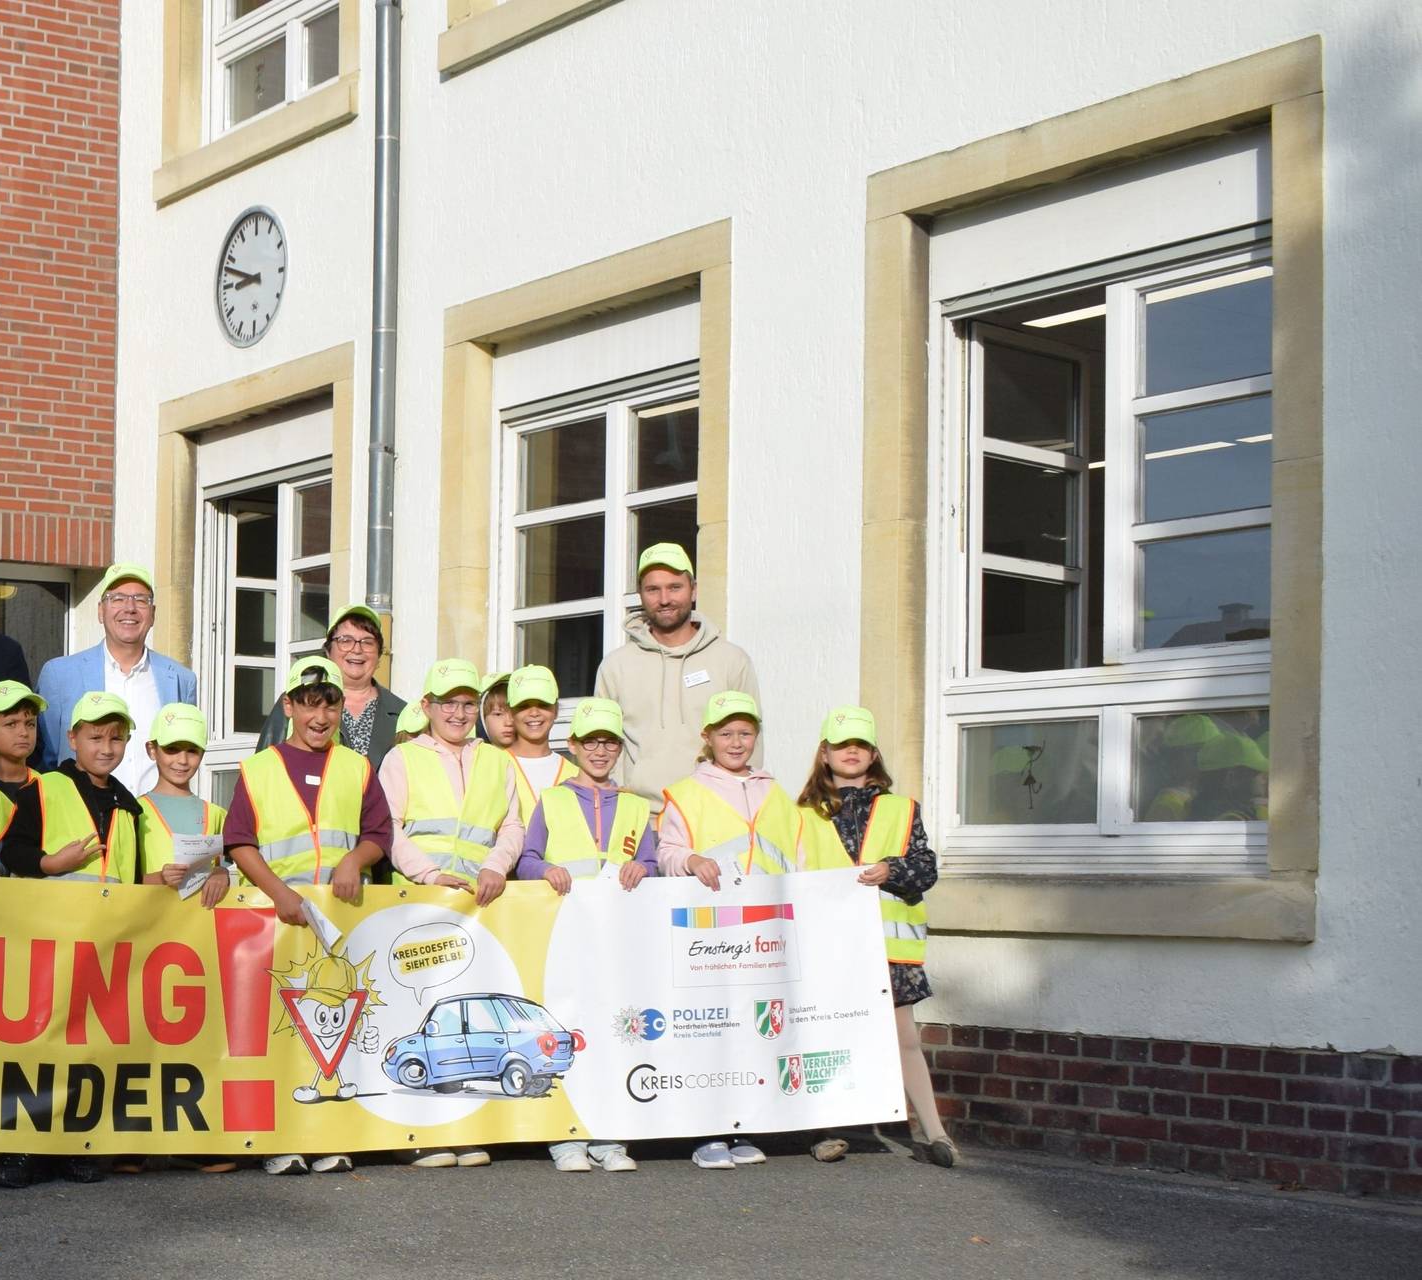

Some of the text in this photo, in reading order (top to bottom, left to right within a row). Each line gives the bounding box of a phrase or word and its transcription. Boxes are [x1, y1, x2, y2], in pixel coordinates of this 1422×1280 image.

[393, 938, 468, 960] KREIS COESFELD
[689, 940, 751, 959] Ernsting's
[406, 952, 461, 970] SIEHT GELB!
[673, 1008, 729, 1021] POLIZEI
[833, 1010, 869, 1020] Coesfeld
[673, 1022, 740, 1030] Nordrhein-Westfalen
[803, 1055, 852, 1069] VERKEHRS
